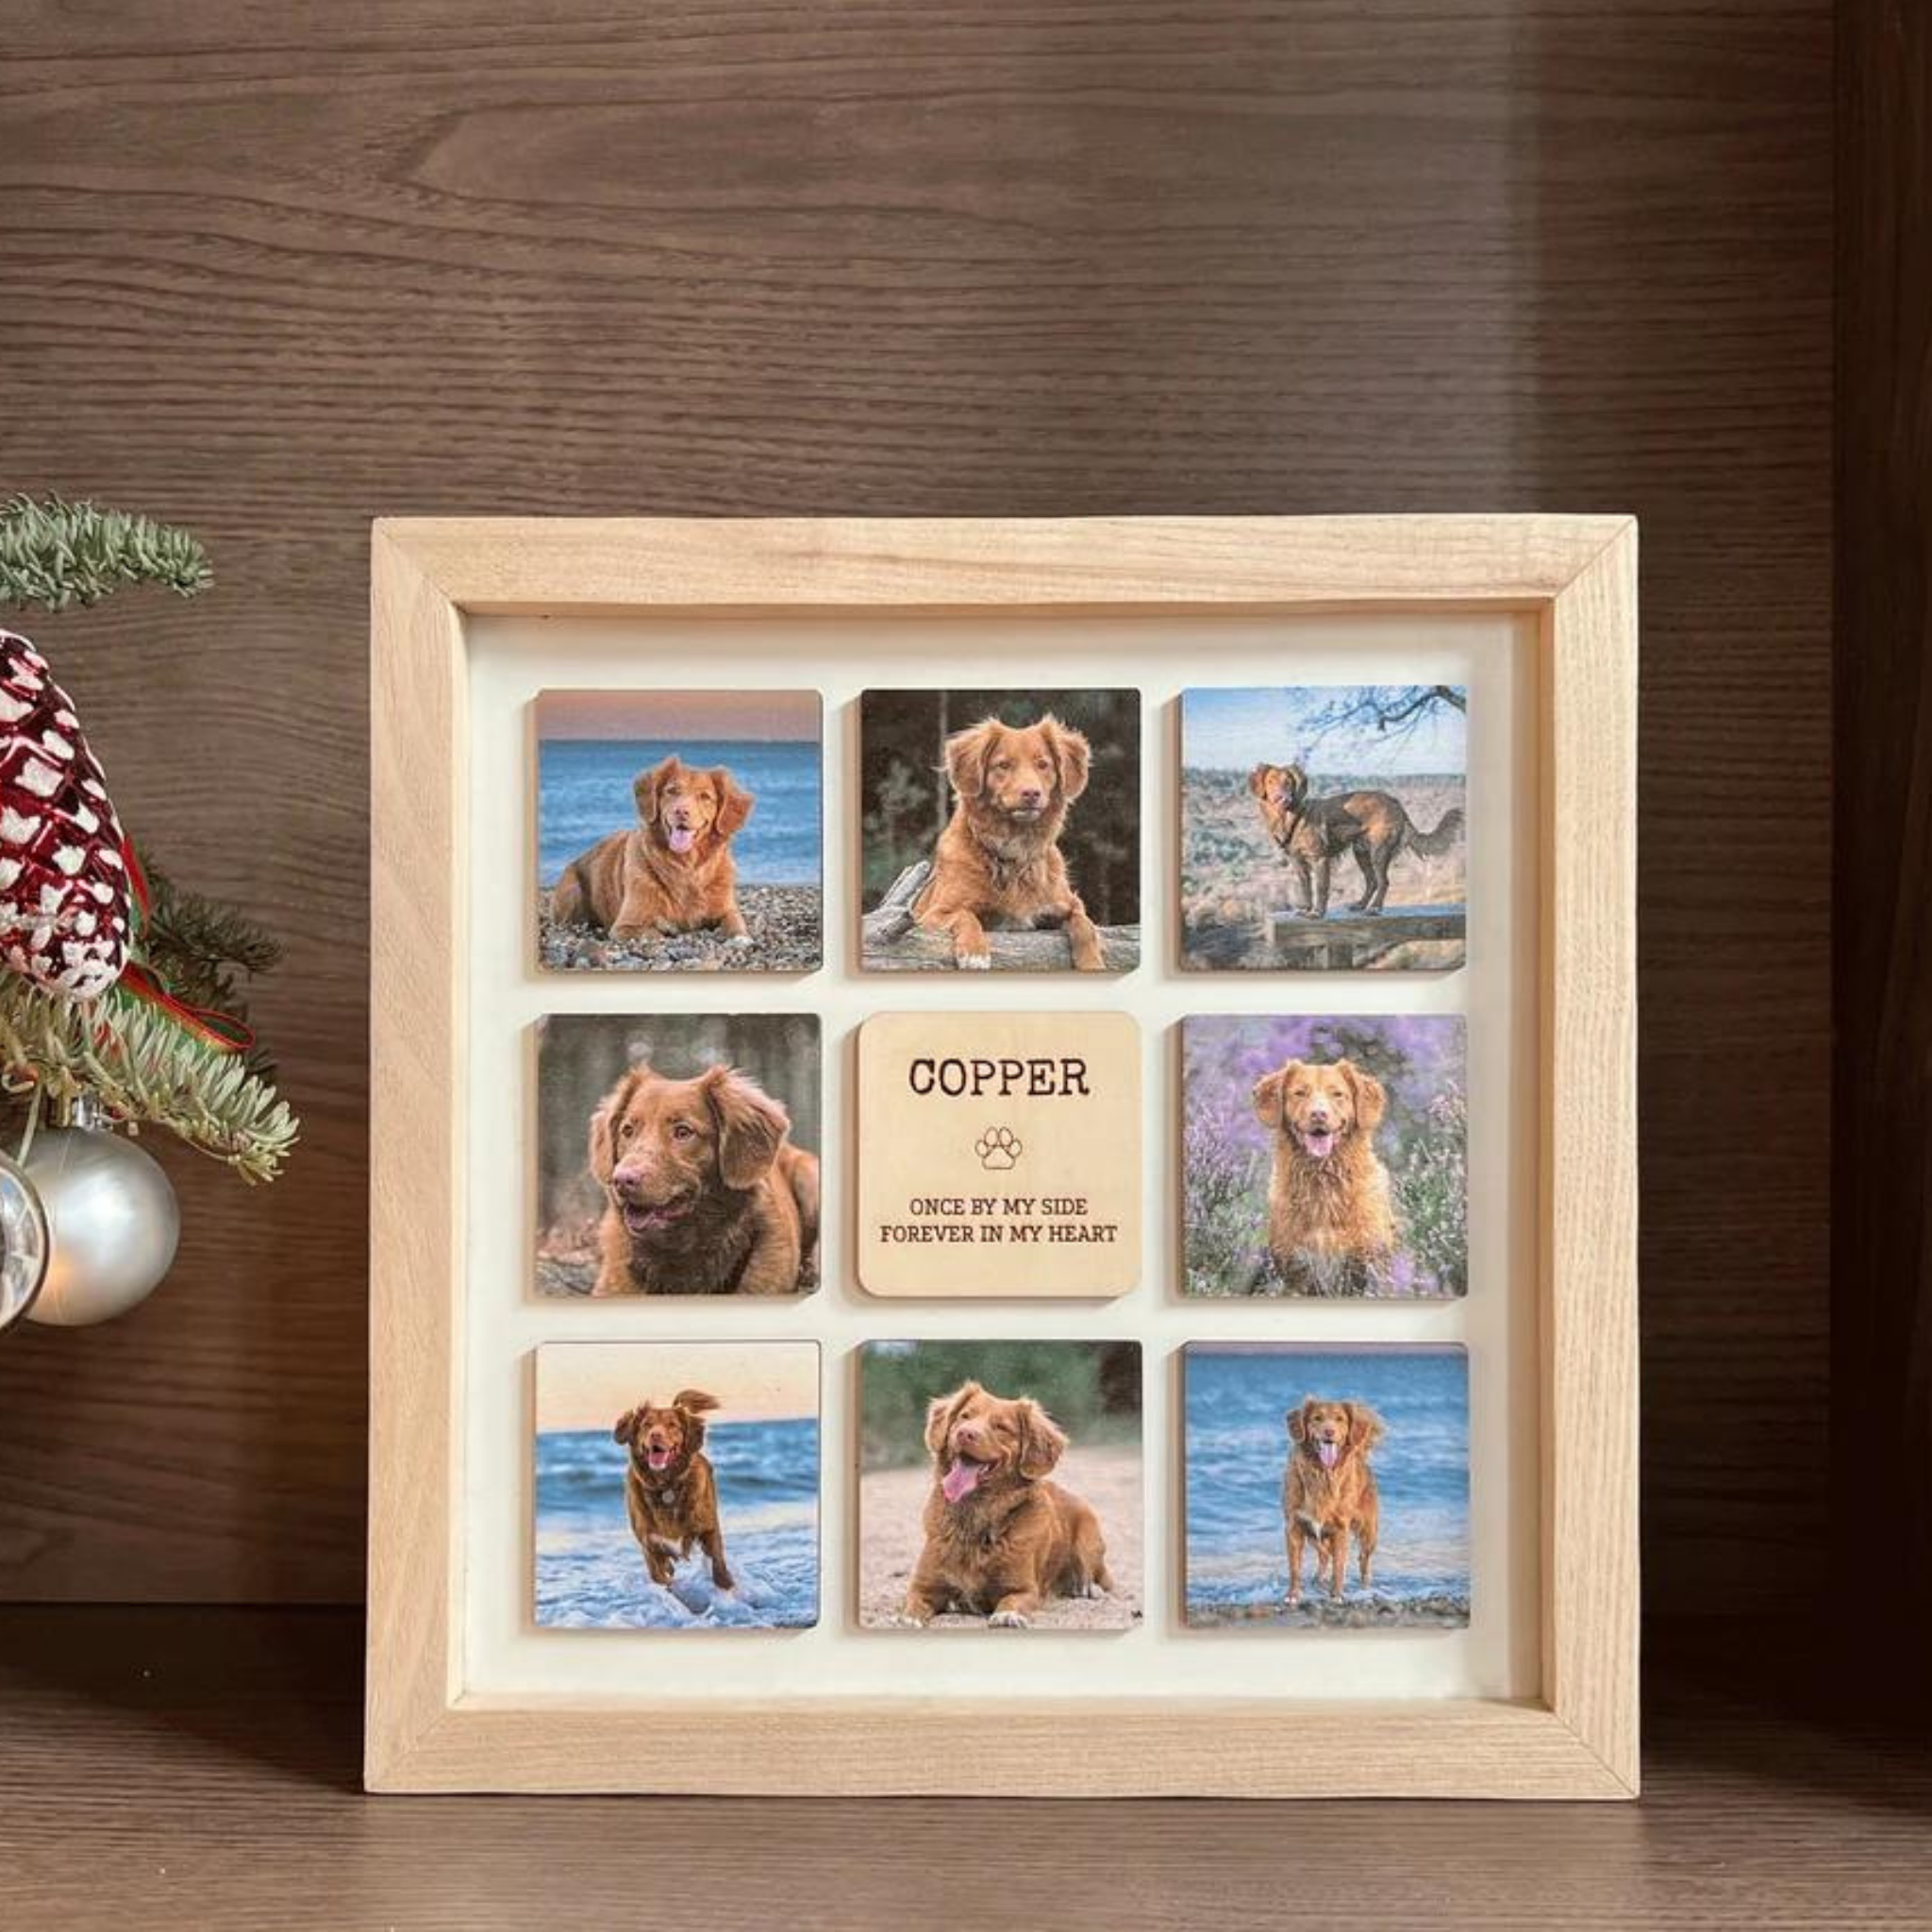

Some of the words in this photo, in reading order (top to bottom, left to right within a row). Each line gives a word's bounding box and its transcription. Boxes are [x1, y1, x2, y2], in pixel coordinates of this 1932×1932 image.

[908, 1058, 1091, 1096] COPPER
[909, 1197, 966, 1215] ONCE
[971, 1197, 997, 1215] BY
[1003, 1197, 1036, 1215] MY
[1041, 1197, 1089, 1215] SIDE
[880, 1224, 974, 1242] FOREVER
[981, 1224, 1003, 1242] IN
[1009, 1224, 1042, 1242] MY
[1049, 1224, 1118, 1242] HEART
